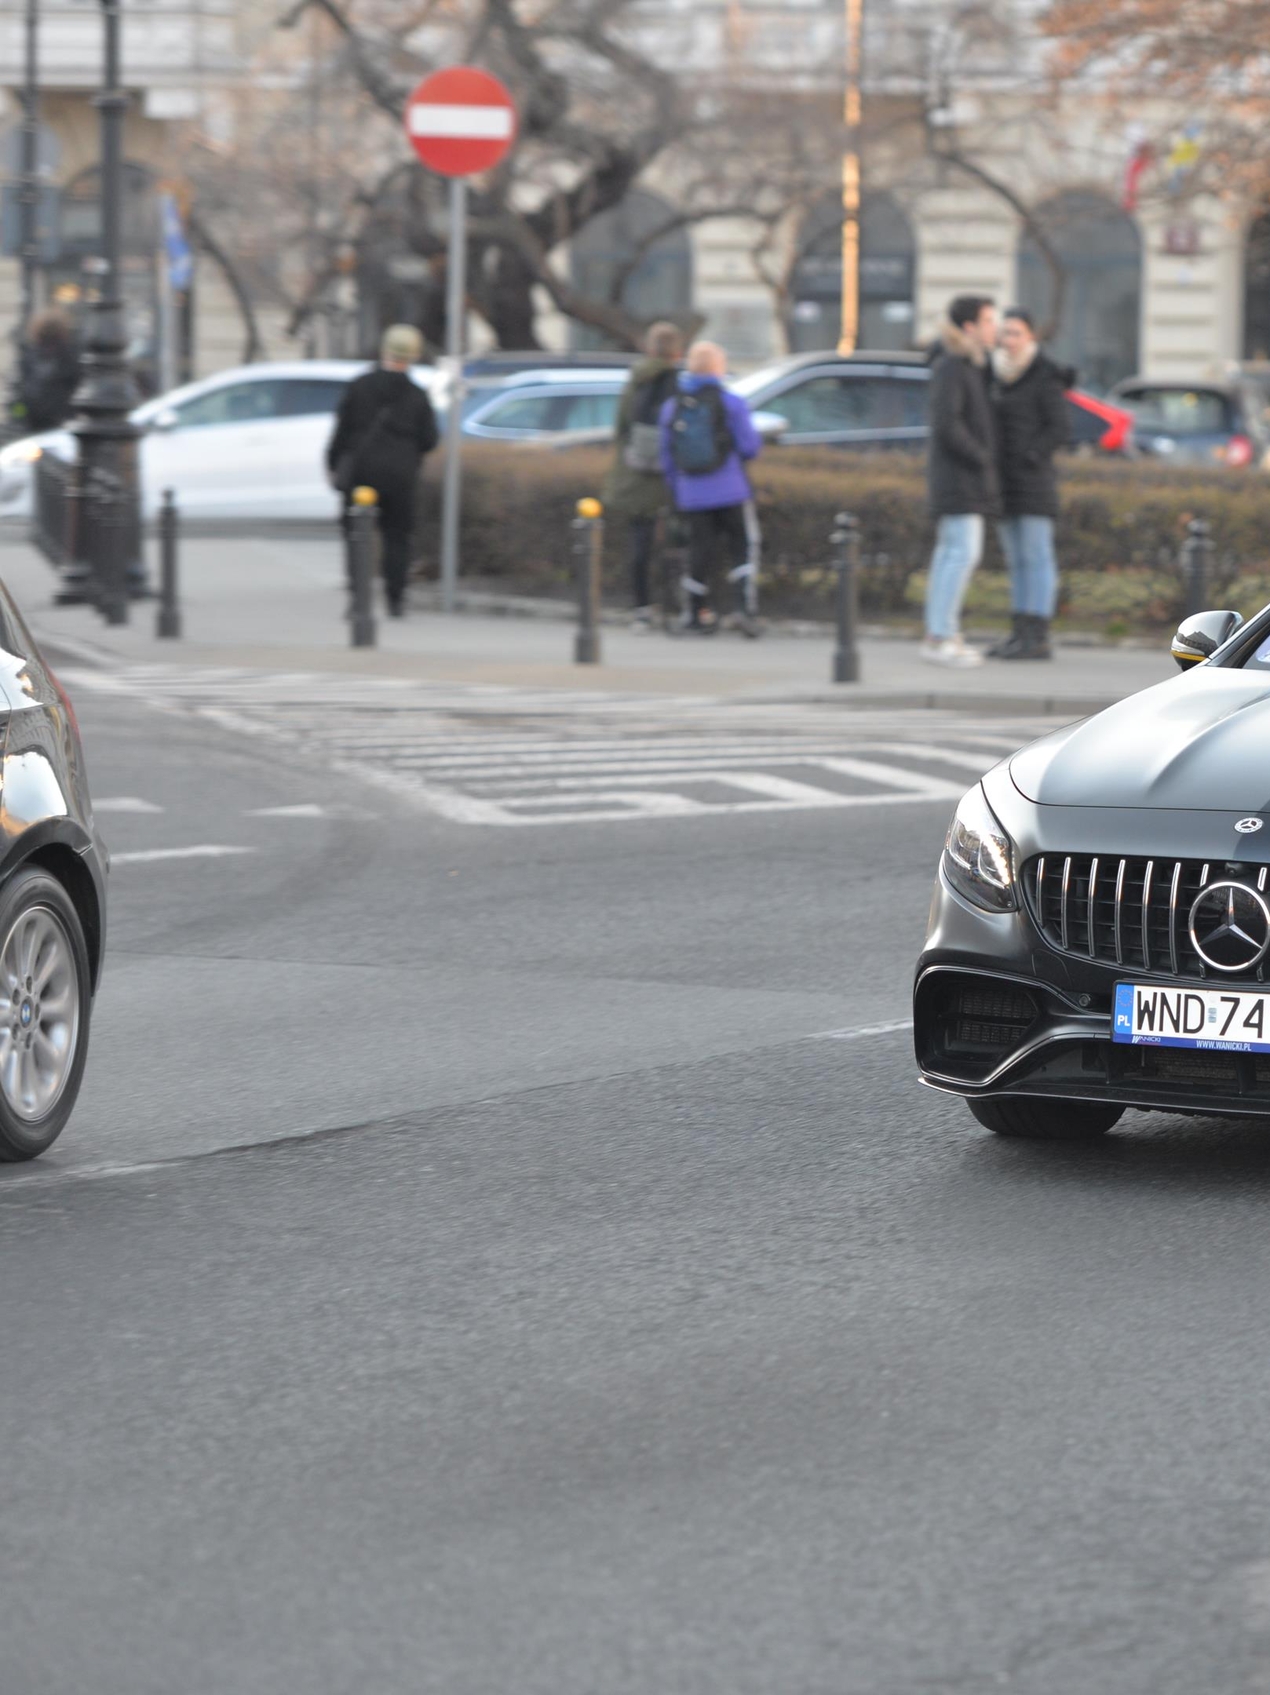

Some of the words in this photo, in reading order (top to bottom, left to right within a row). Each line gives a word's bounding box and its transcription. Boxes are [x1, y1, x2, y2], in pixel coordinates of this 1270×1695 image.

[1137, 991, 1205, 1033] WND
[1117, 1015, 1131, 1027] PL
[1196, 1040, 1252, 1052] WWW.WANICKI.PL
